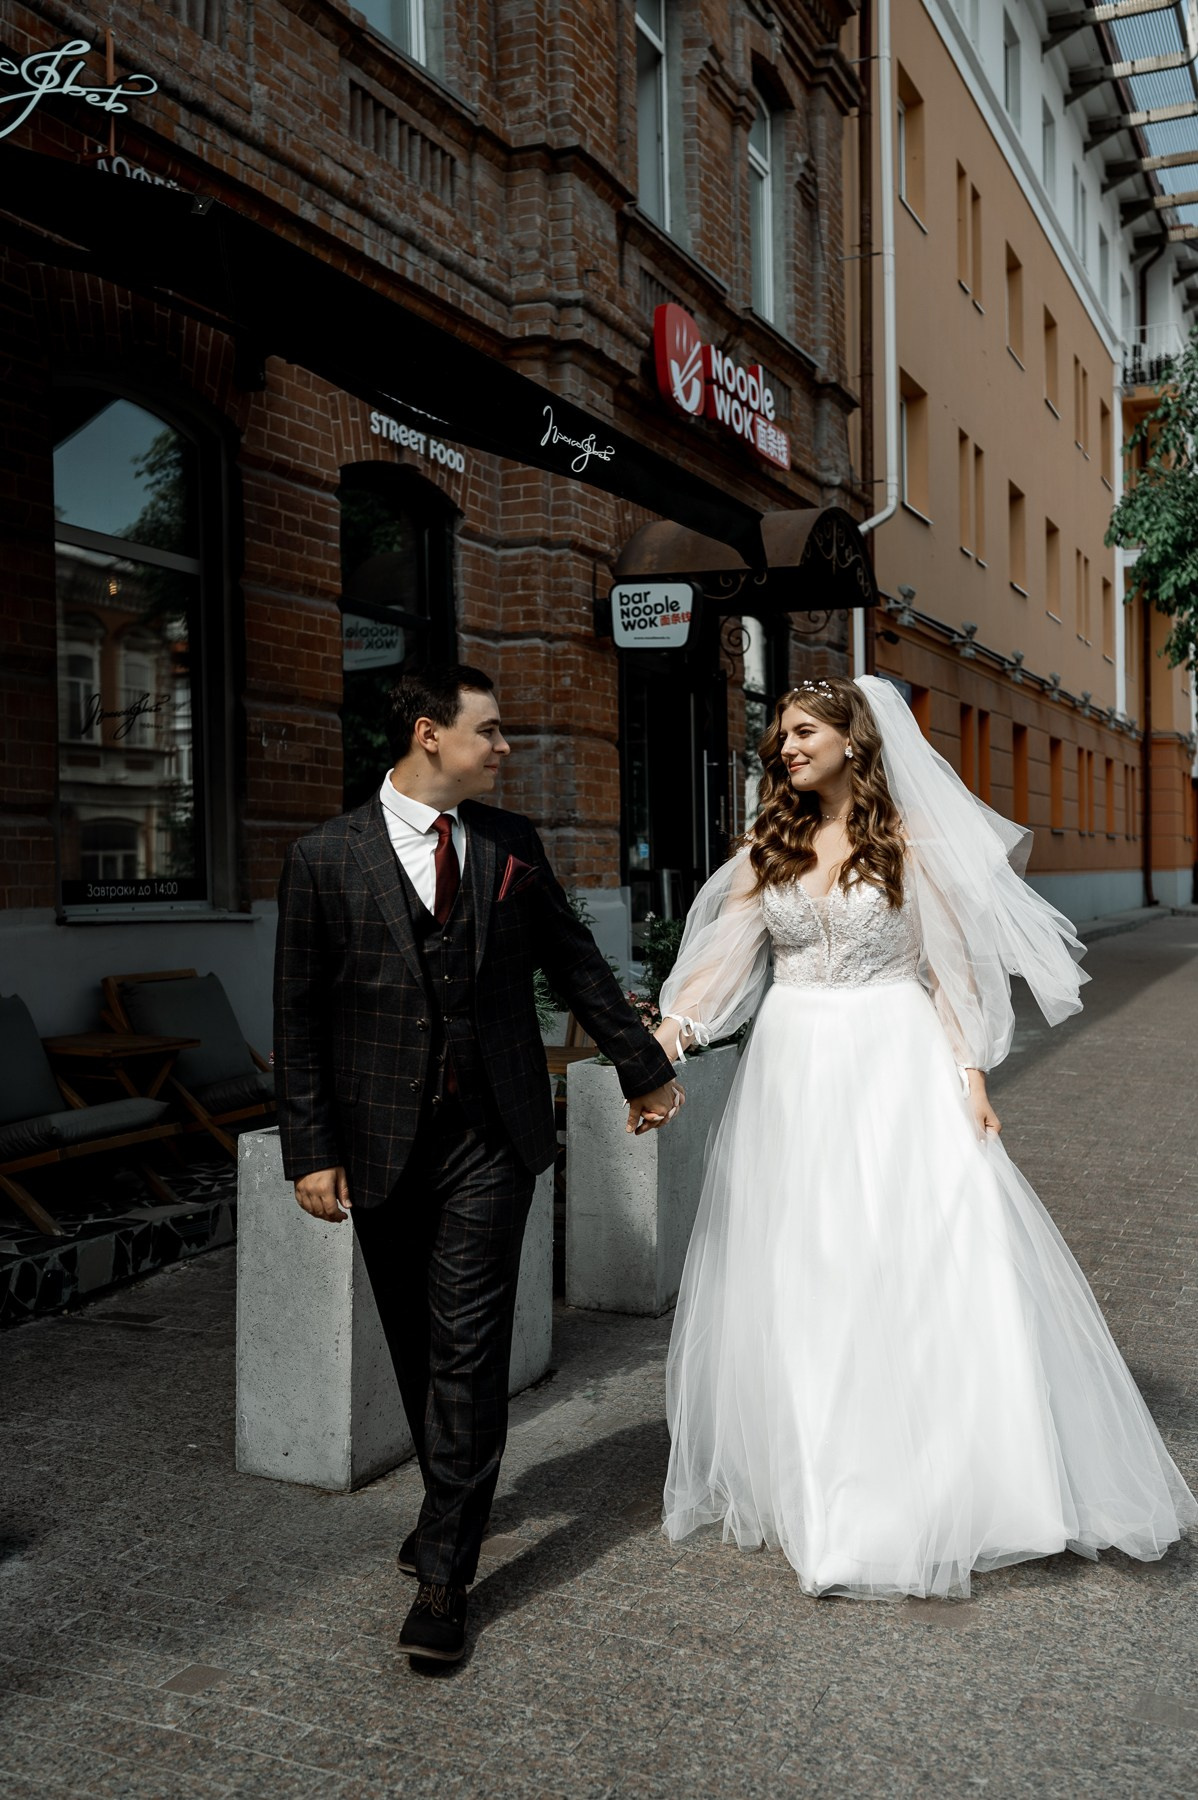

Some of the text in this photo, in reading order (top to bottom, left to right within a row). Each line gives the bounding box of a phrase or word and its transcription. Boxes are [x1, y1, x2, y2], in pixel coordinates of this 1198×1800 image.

[713, 385, 756, 444] WOK
[429, 439, 466, 473] FOOD
[618, 591, 651, 606] bar
[621, 616, 659, 632] WOK
[86, 881, 179, 899] Завтраки до 14:00
